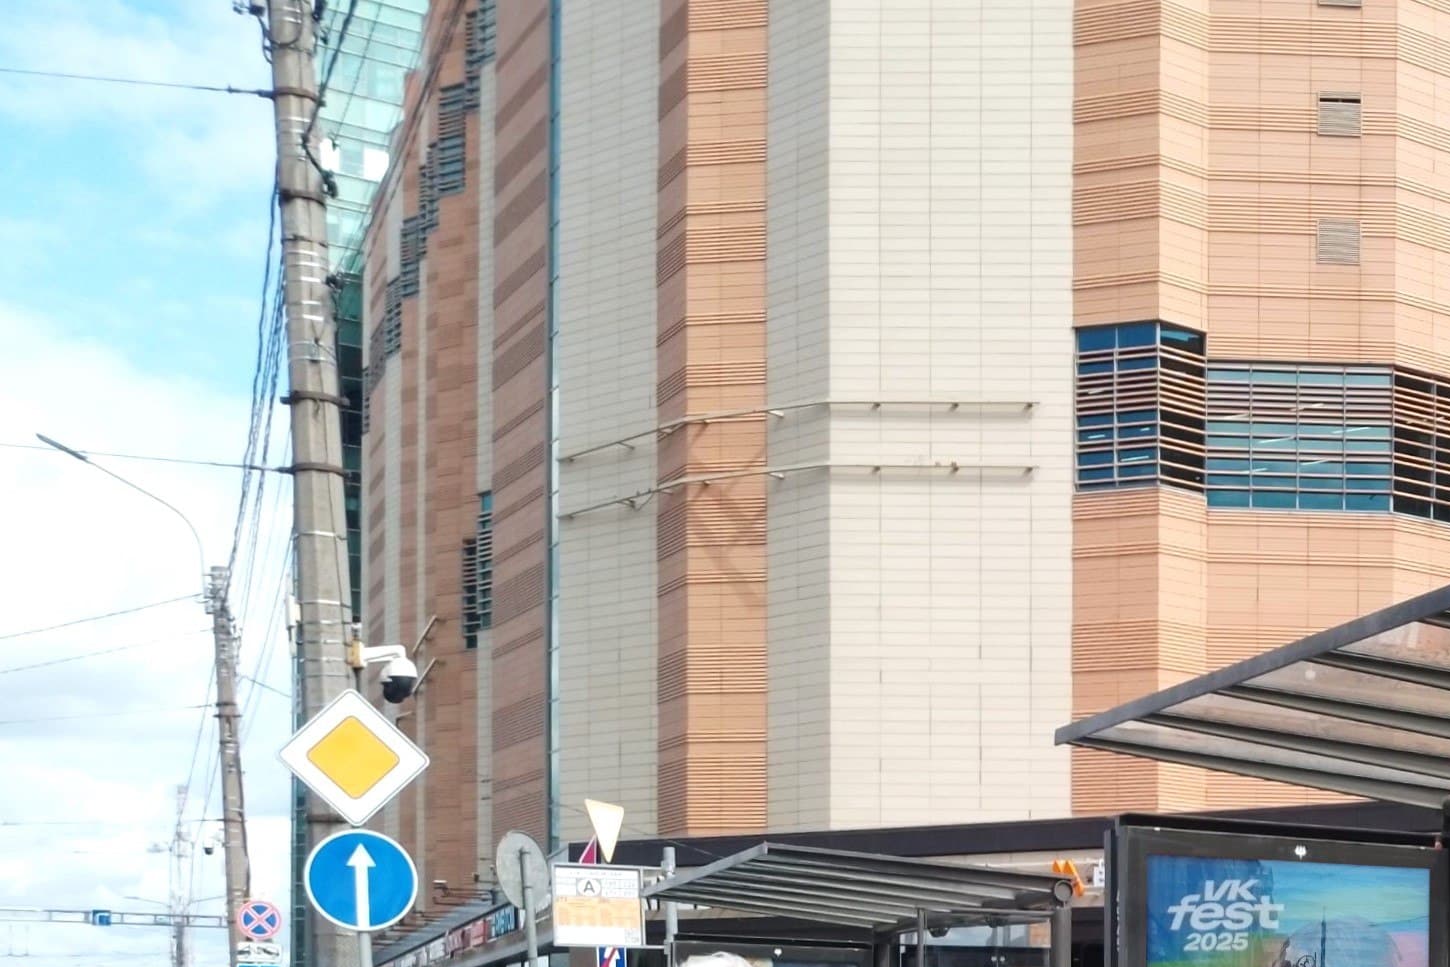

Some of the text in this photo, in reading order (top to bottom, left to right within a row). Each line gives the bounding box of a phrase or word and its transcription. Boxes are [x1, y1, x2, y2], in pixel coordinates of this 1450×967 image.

[1203, 879, 1261, 902] VK
[1167, 893, 1285, 931] fest
[1183, 931, 1249, 952] 2025
